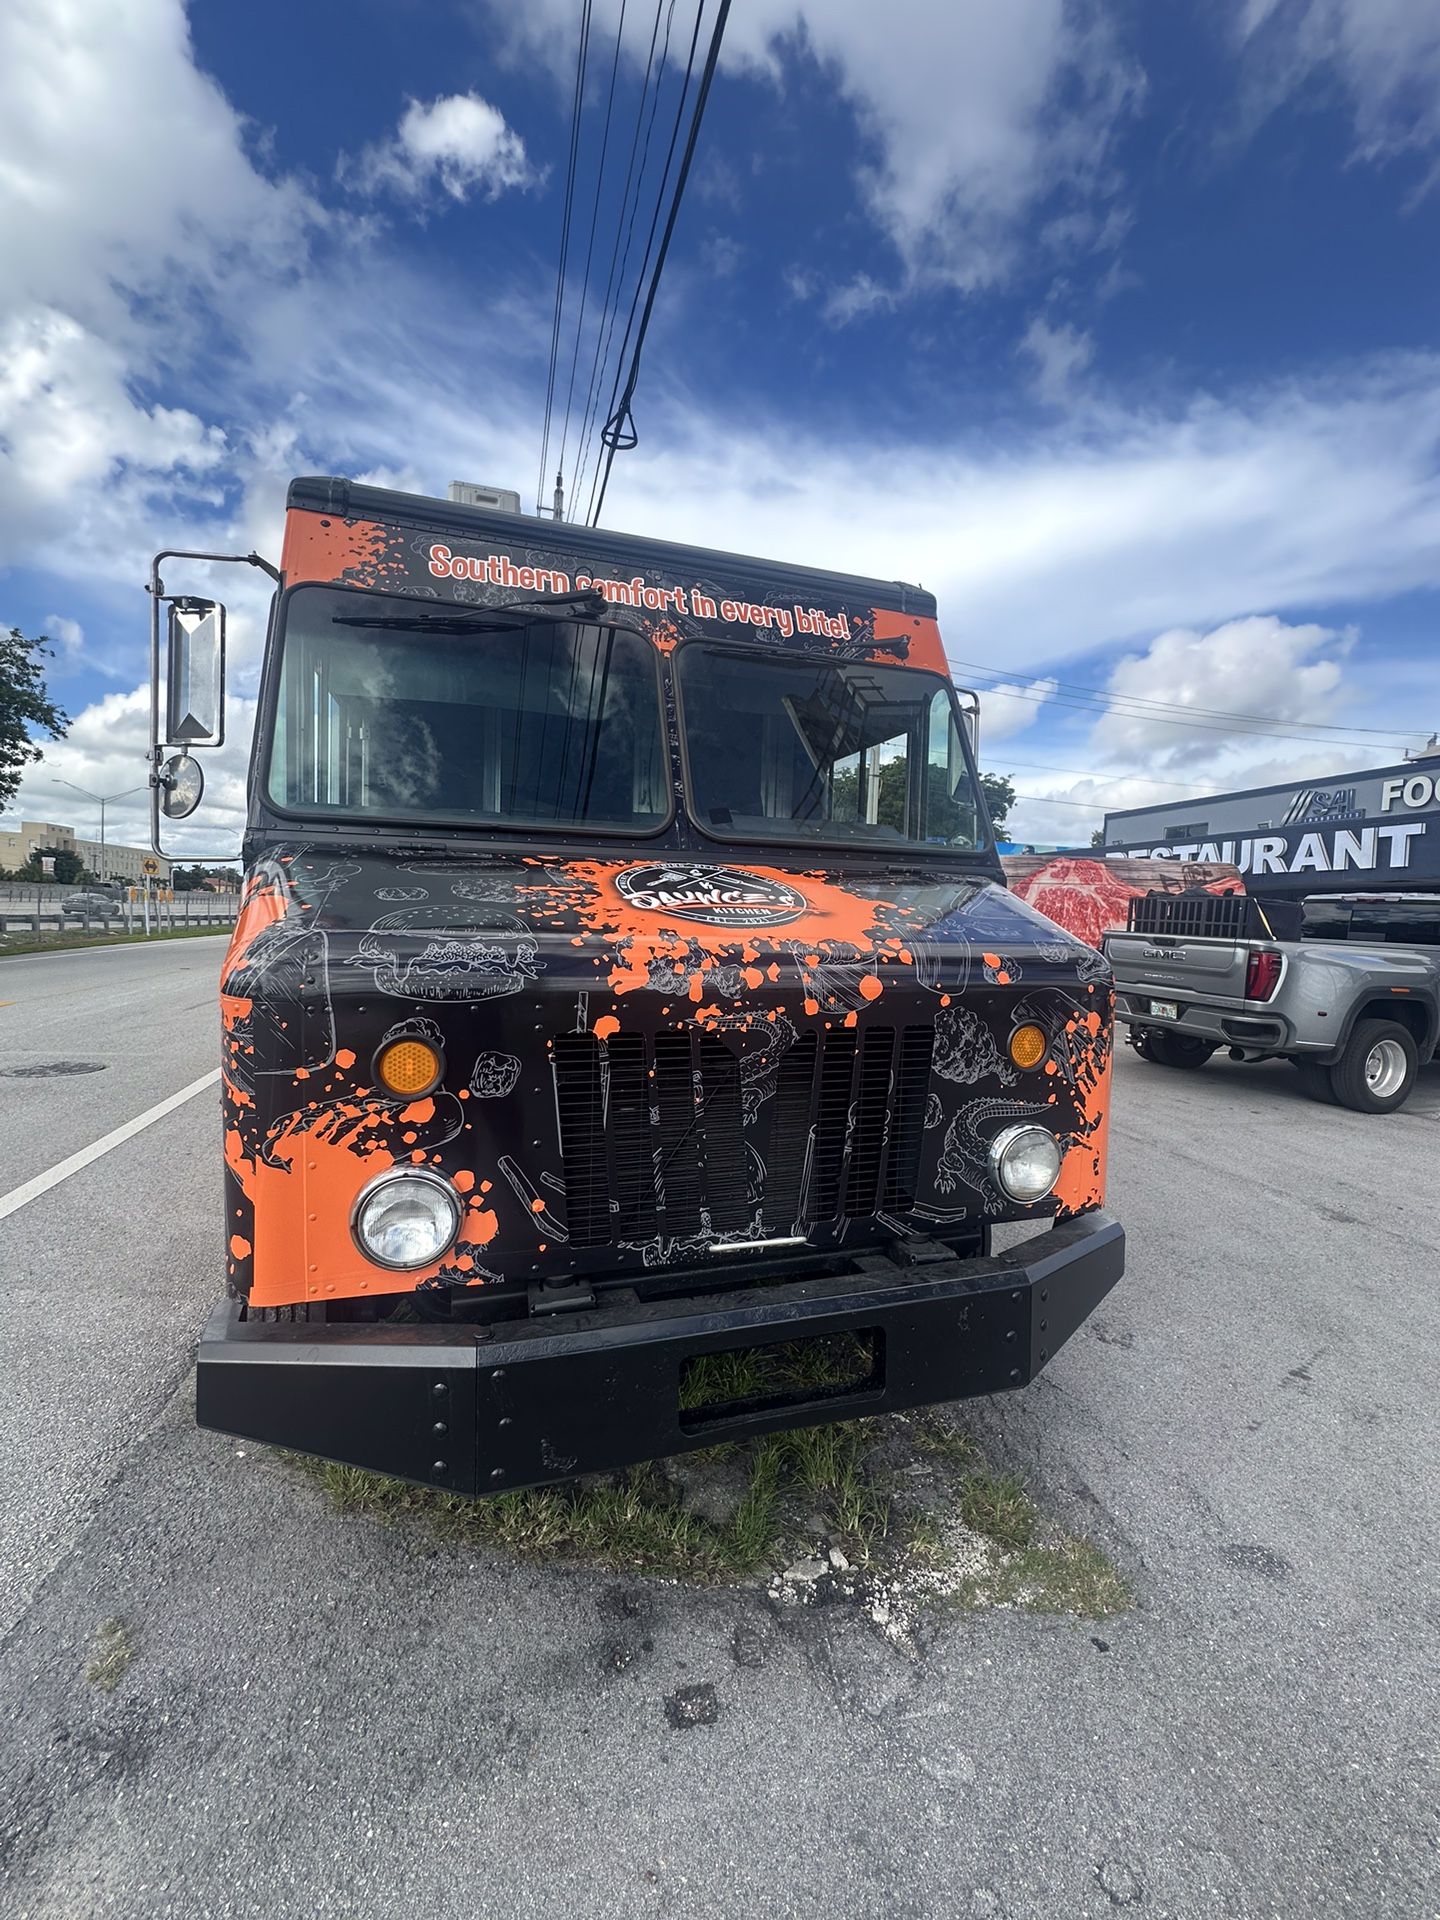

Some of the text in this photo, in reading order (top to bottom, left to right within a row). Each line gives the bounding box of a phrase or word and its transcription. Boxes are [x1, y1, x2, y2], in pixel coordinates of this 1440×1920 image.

[428, 544, 570, 594] Southern
[691, 588, 717, 618] in
[720, 600, 794, 637] every
[794, 605, 851, 640] bite!
[1381, 775, 1440, 811] FO
[1104, 822, 1427, 876] TAURANT
[712, 906, 772, 916] KITCHEN
[1142, 947, 1187, 960] GMC
